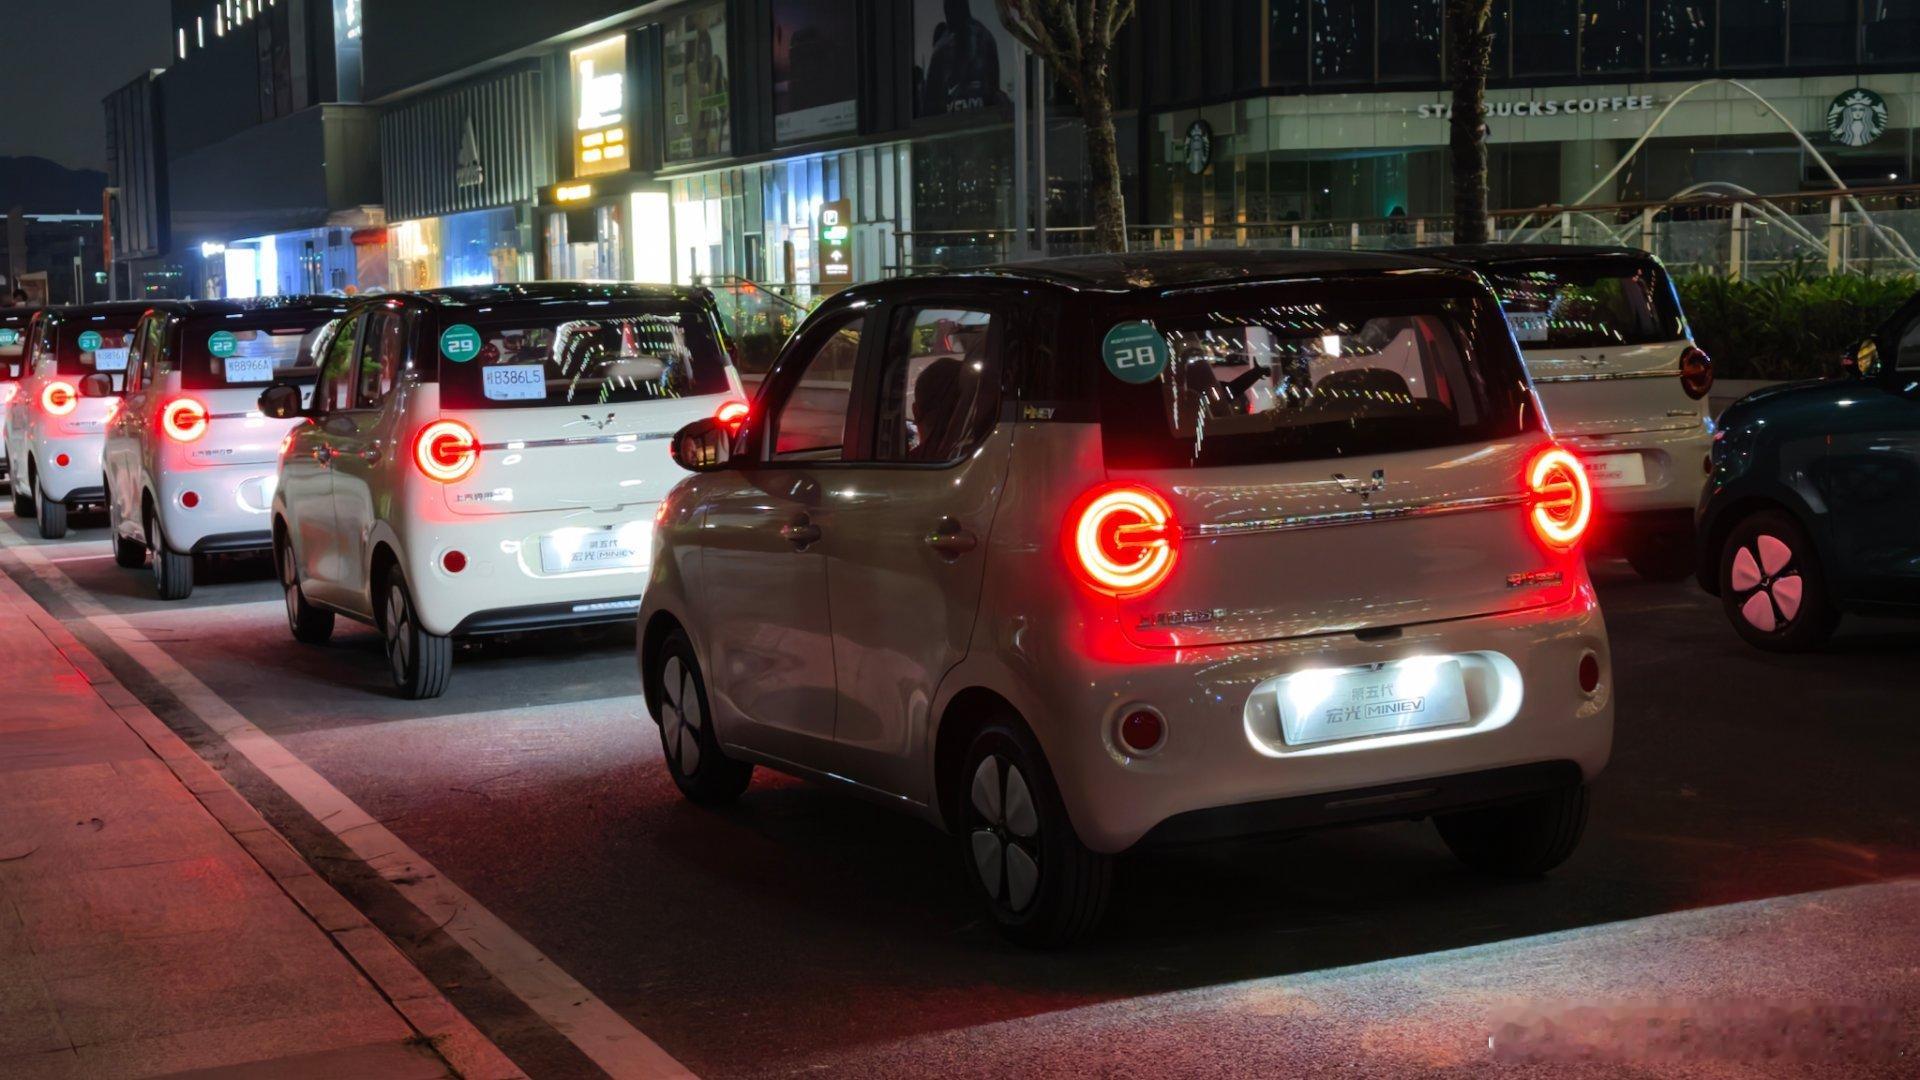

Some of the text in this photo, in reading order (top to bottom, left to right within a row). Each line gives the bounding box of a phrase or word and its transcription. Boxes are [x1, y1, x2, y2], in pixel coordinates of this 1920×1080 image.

[1417, 95, 1653, 119] STBUCKS COFFEE
[213, 341, 233, 352] 22
[447, 339, 474, 353] 29
[1114, 346, 1156, 369] 28
[1351, 683, 1394, 701] 第五代
[1325, 699, 1424, 724] 宏光 MINIEV
